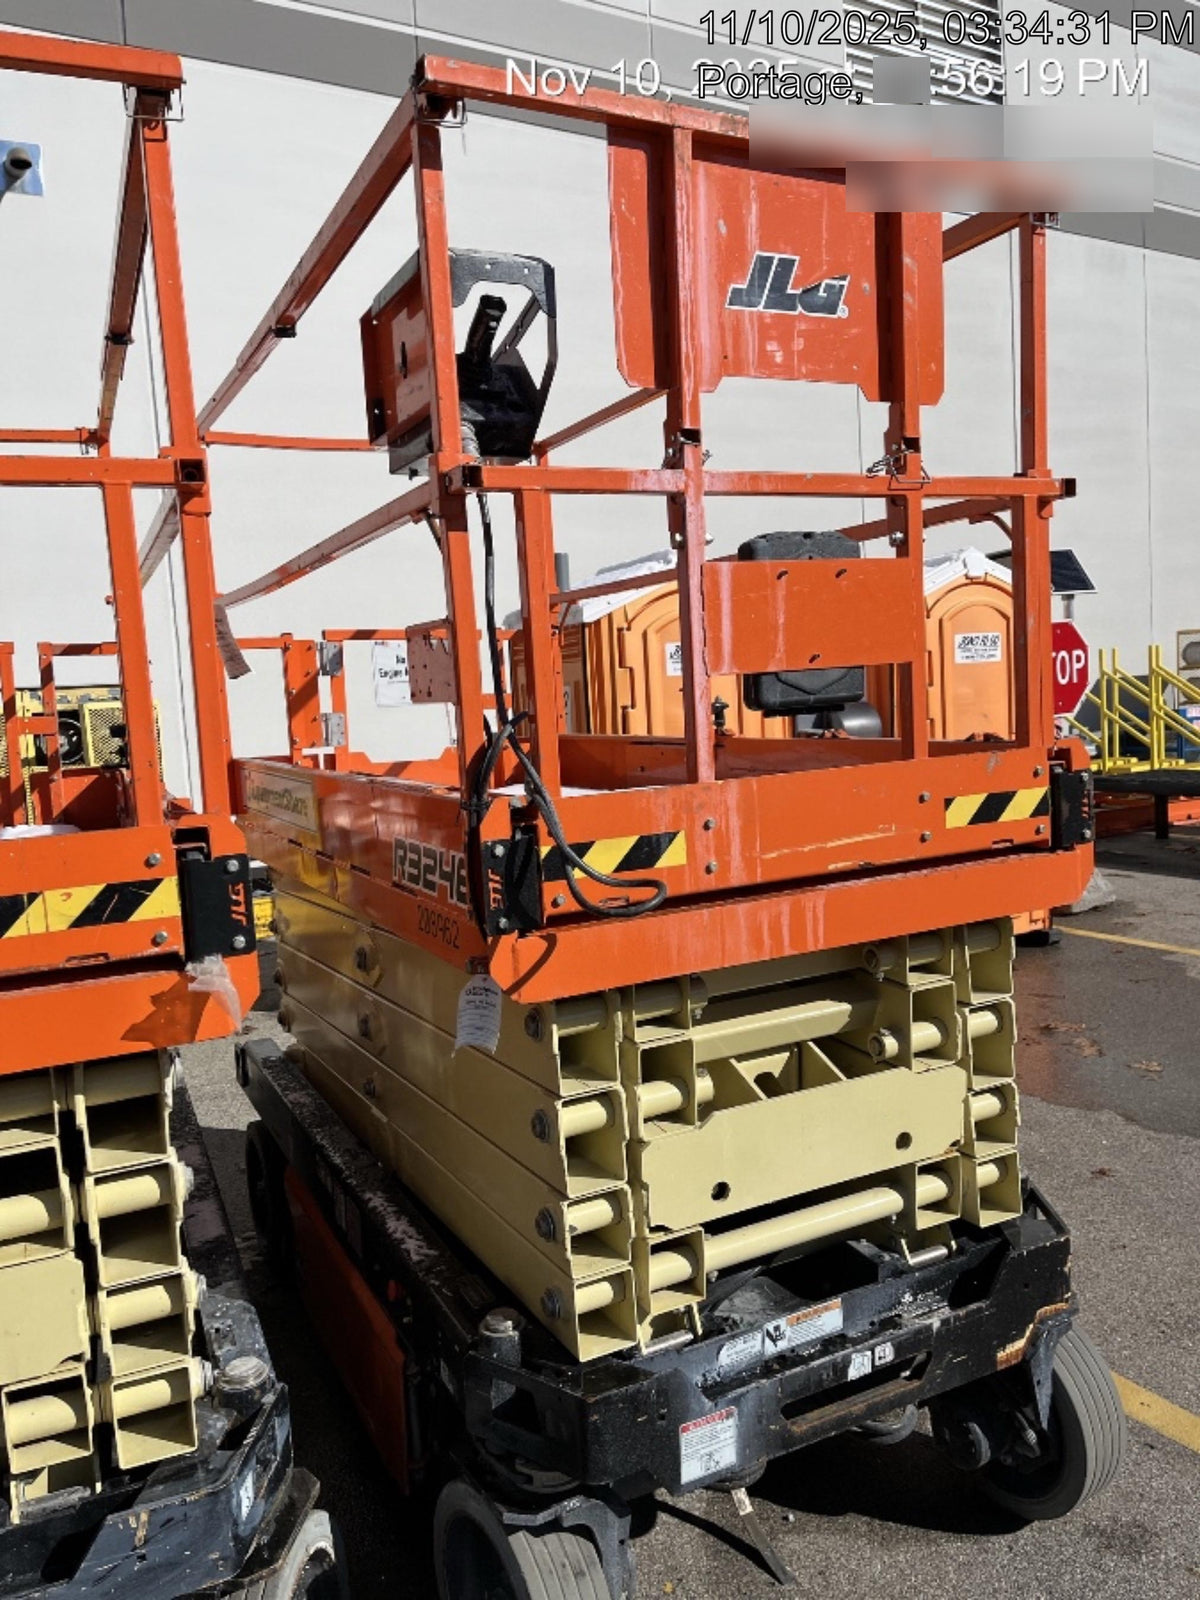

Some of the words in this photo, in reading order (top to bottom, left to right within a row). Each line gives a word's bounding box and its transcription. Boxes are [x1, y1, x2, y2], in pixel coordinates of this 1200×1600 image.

[725, 250, 850, 319] JLG
[1052, 648, 1087, 686] OP
[228, 882, 248, 928] JLG
